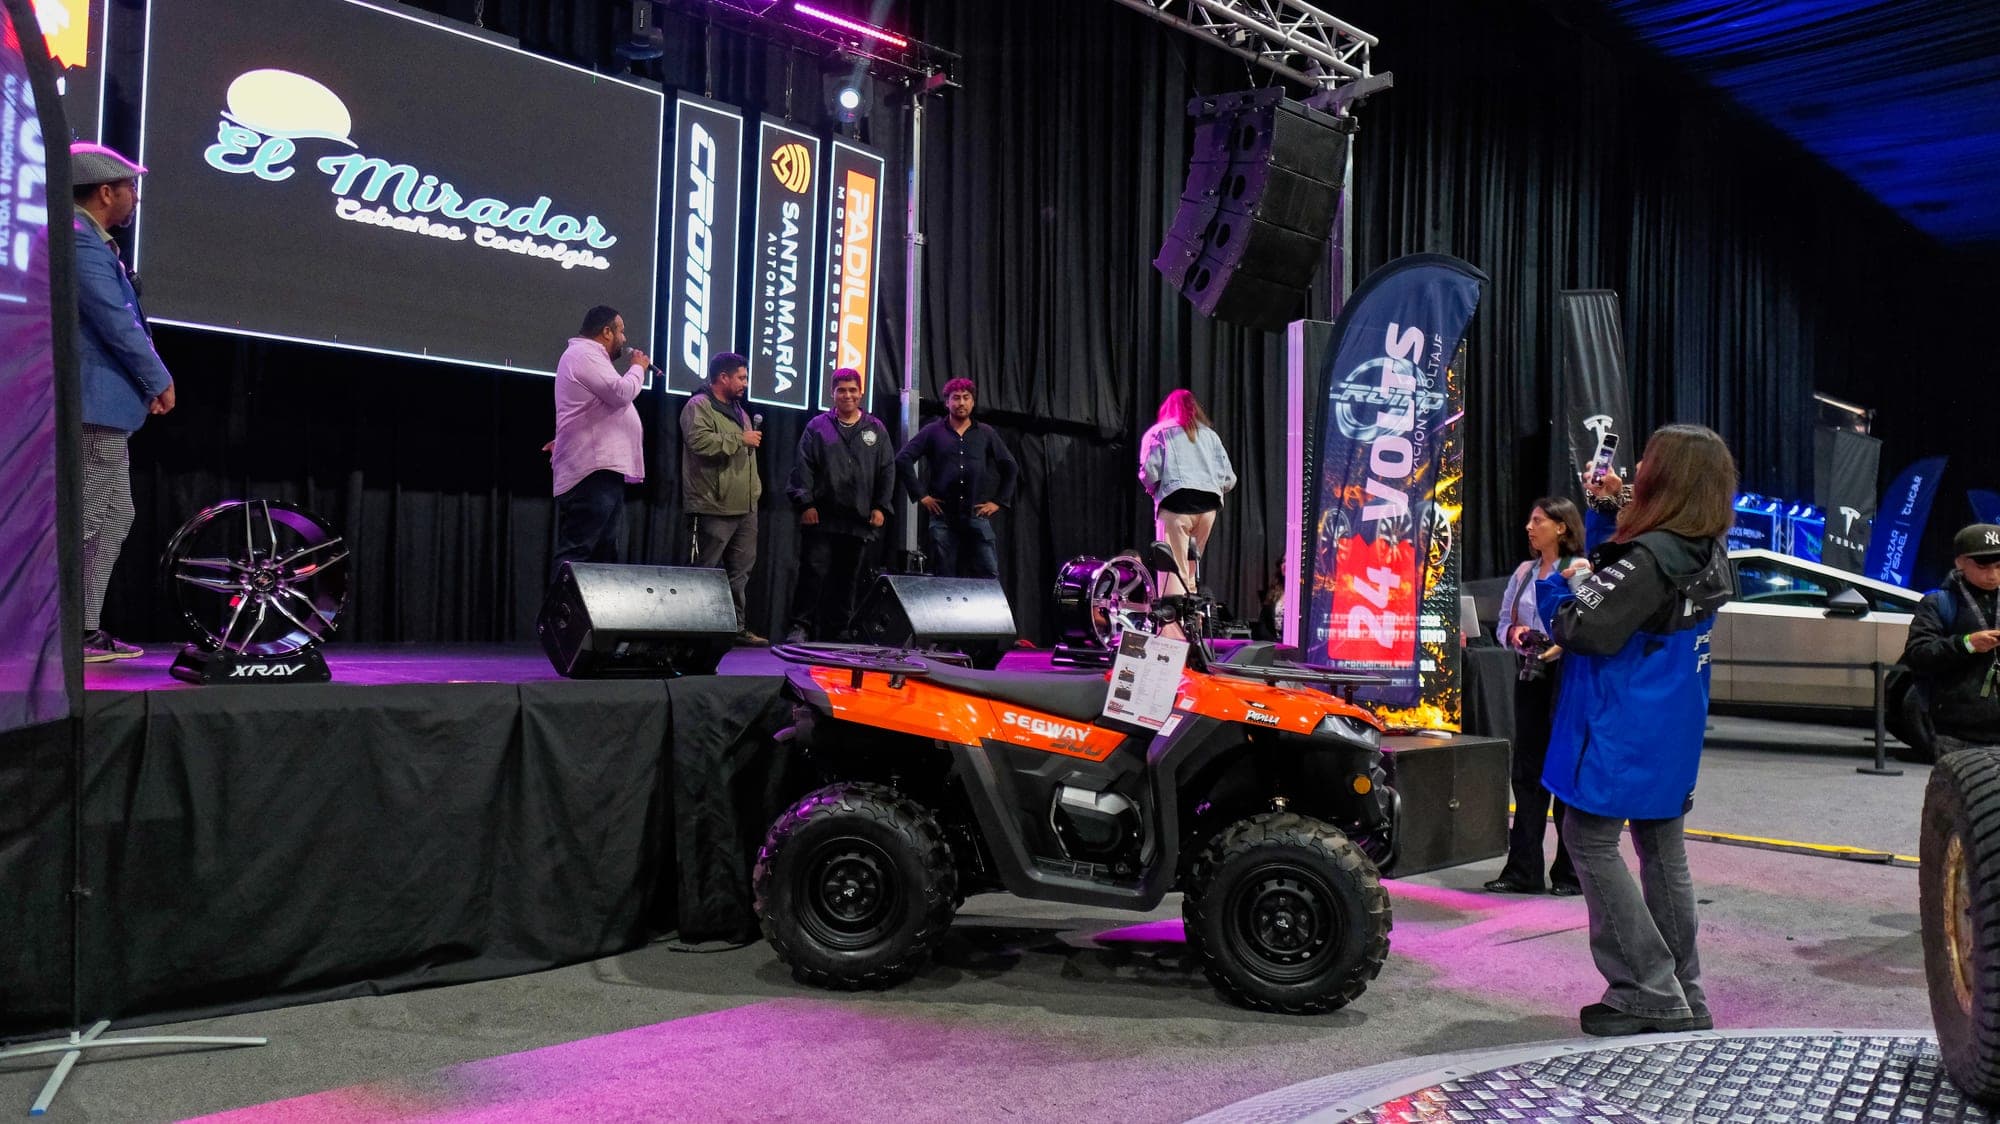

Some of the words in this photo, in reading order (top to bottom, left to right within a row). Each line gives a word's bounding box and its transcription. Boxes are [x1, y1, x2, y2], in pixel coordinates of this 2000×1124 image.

[204, 120, 296, 181] El
[317, 153, 617, 248] Mirador
[683, 122, 716, 379] CROMO
[762, 232, 778, 356] AUTOMOTRIZ
[781, 201, 800, 296] SANTA
[828, 186, 845, 371] MOTORSPORT
[842, 188, 872, 369] PADILLA
[774, 300, 798, 394] MARÍA
[1362, 322, 1425, 521] VOLTS
[1829, 534, 1864, 552] TESLA
[1881, 529, 1900, 580] SALAZAR
[1348, 567, 1401, 649] 24
[229, 664, 306, 677] XRAY
[1002, 711, 1091, 742] SEGWAY
